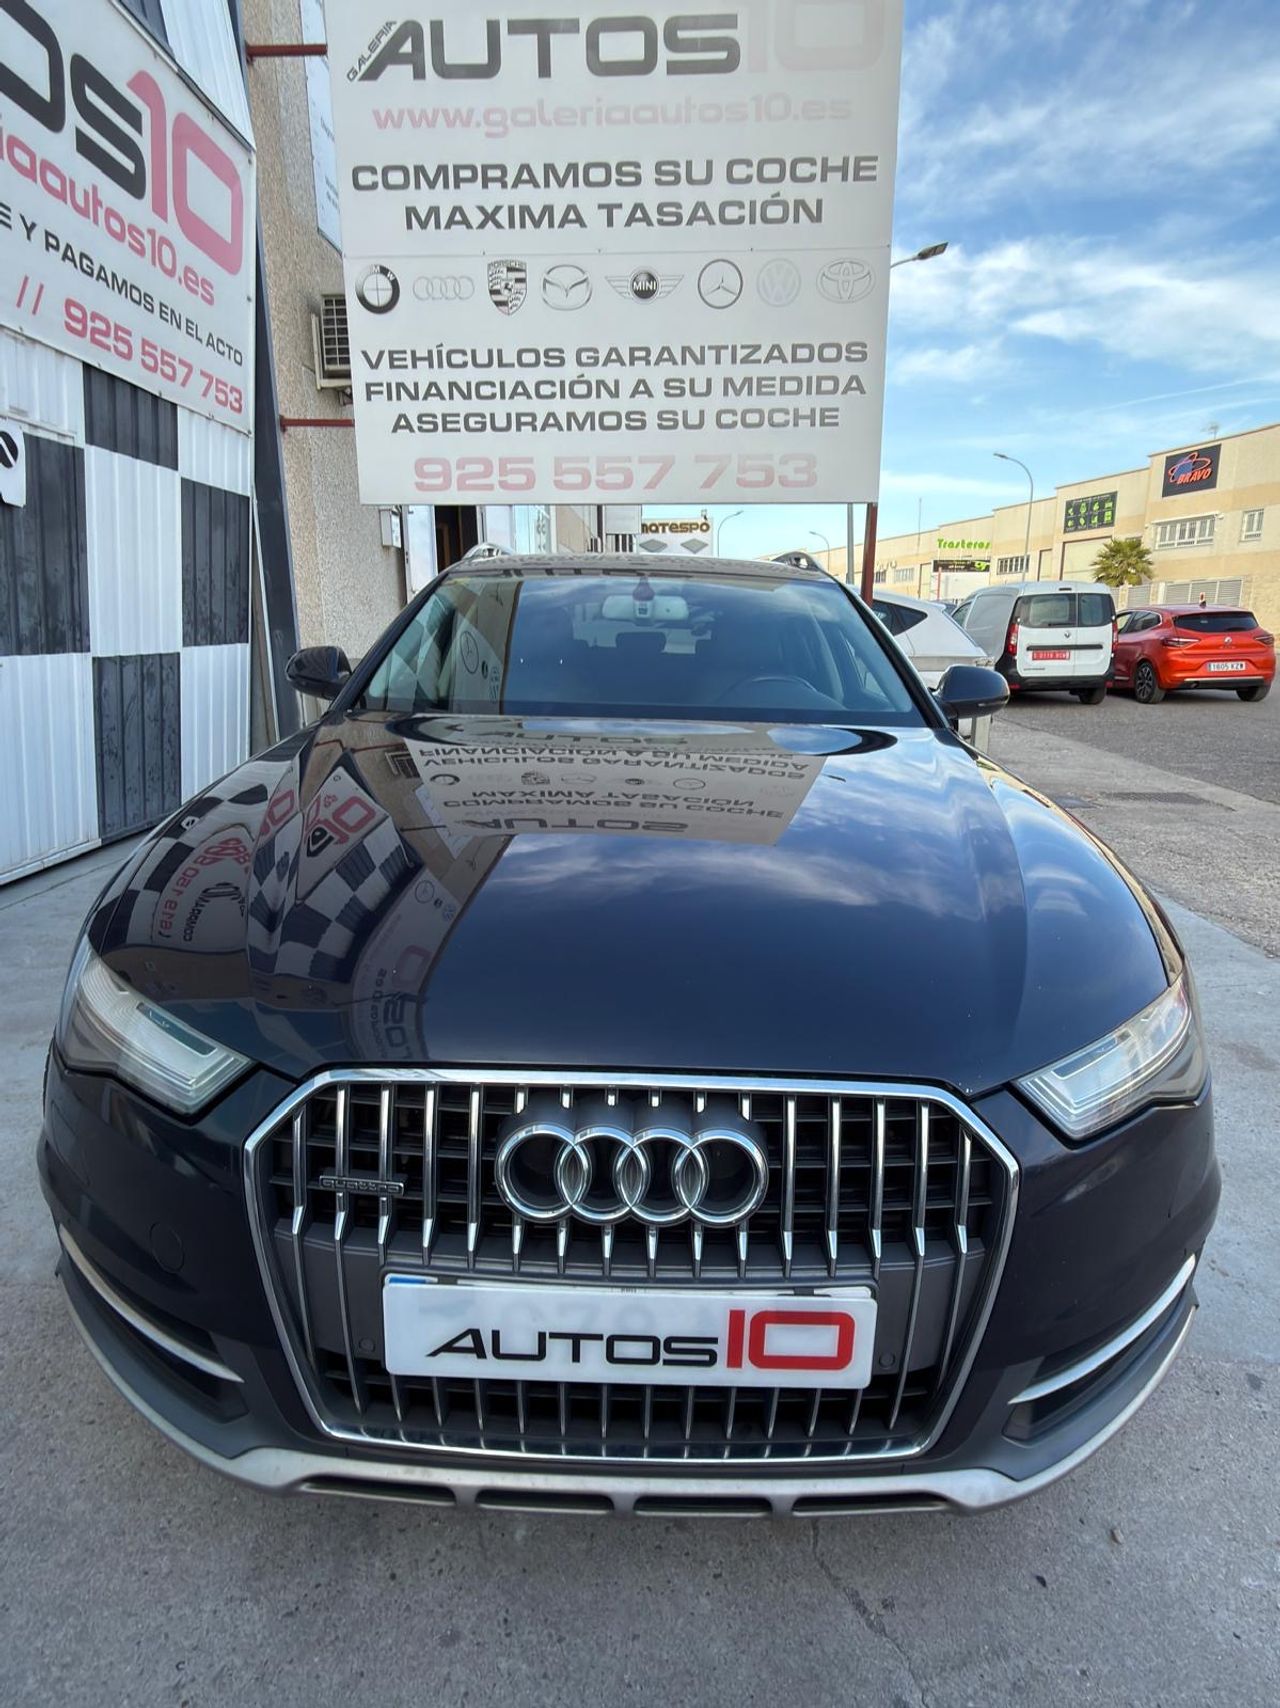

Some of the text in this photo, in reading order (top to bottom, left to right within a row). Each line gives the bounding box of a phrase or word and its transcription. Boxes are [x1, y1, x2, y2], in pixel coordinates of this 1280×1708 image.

[346, 20, 397, 82] GALERIA
[372, 92, 852, 138] www.galeriaautos10.es
[352, 156, 879, 191] COMPRAMOS SU COCHE
[405, 192, 823, 231] MAXIMA TASACIÓN
[19, 213, 37, 241] Y
[44, 229, 155, 314] PAGAMOS
[159, 301, 182, 330] EN
[185, 317, 203, 345] EL
[206, 332, 243, 366] ACTO
[633, 281, 656, 291] MINI
[64, 297, 133, 362] 925
[141, 337, 194, 388] 557
[200, 371, 243, 415] 753
[361, 342, 868, 370] VEHÍCULOS GARANTIZADOS
[365, 373, 866, 402] FINANCIACIÓN A SU MEDIDA
[391, 407, 839, 433] ASEGURAMOS SU COCHE
[414, 453, 818, 492] 925 557 753
[1176, 467, 1212, 485] BRAVO
[425, 1309, 855, 1371] AUTOS10
